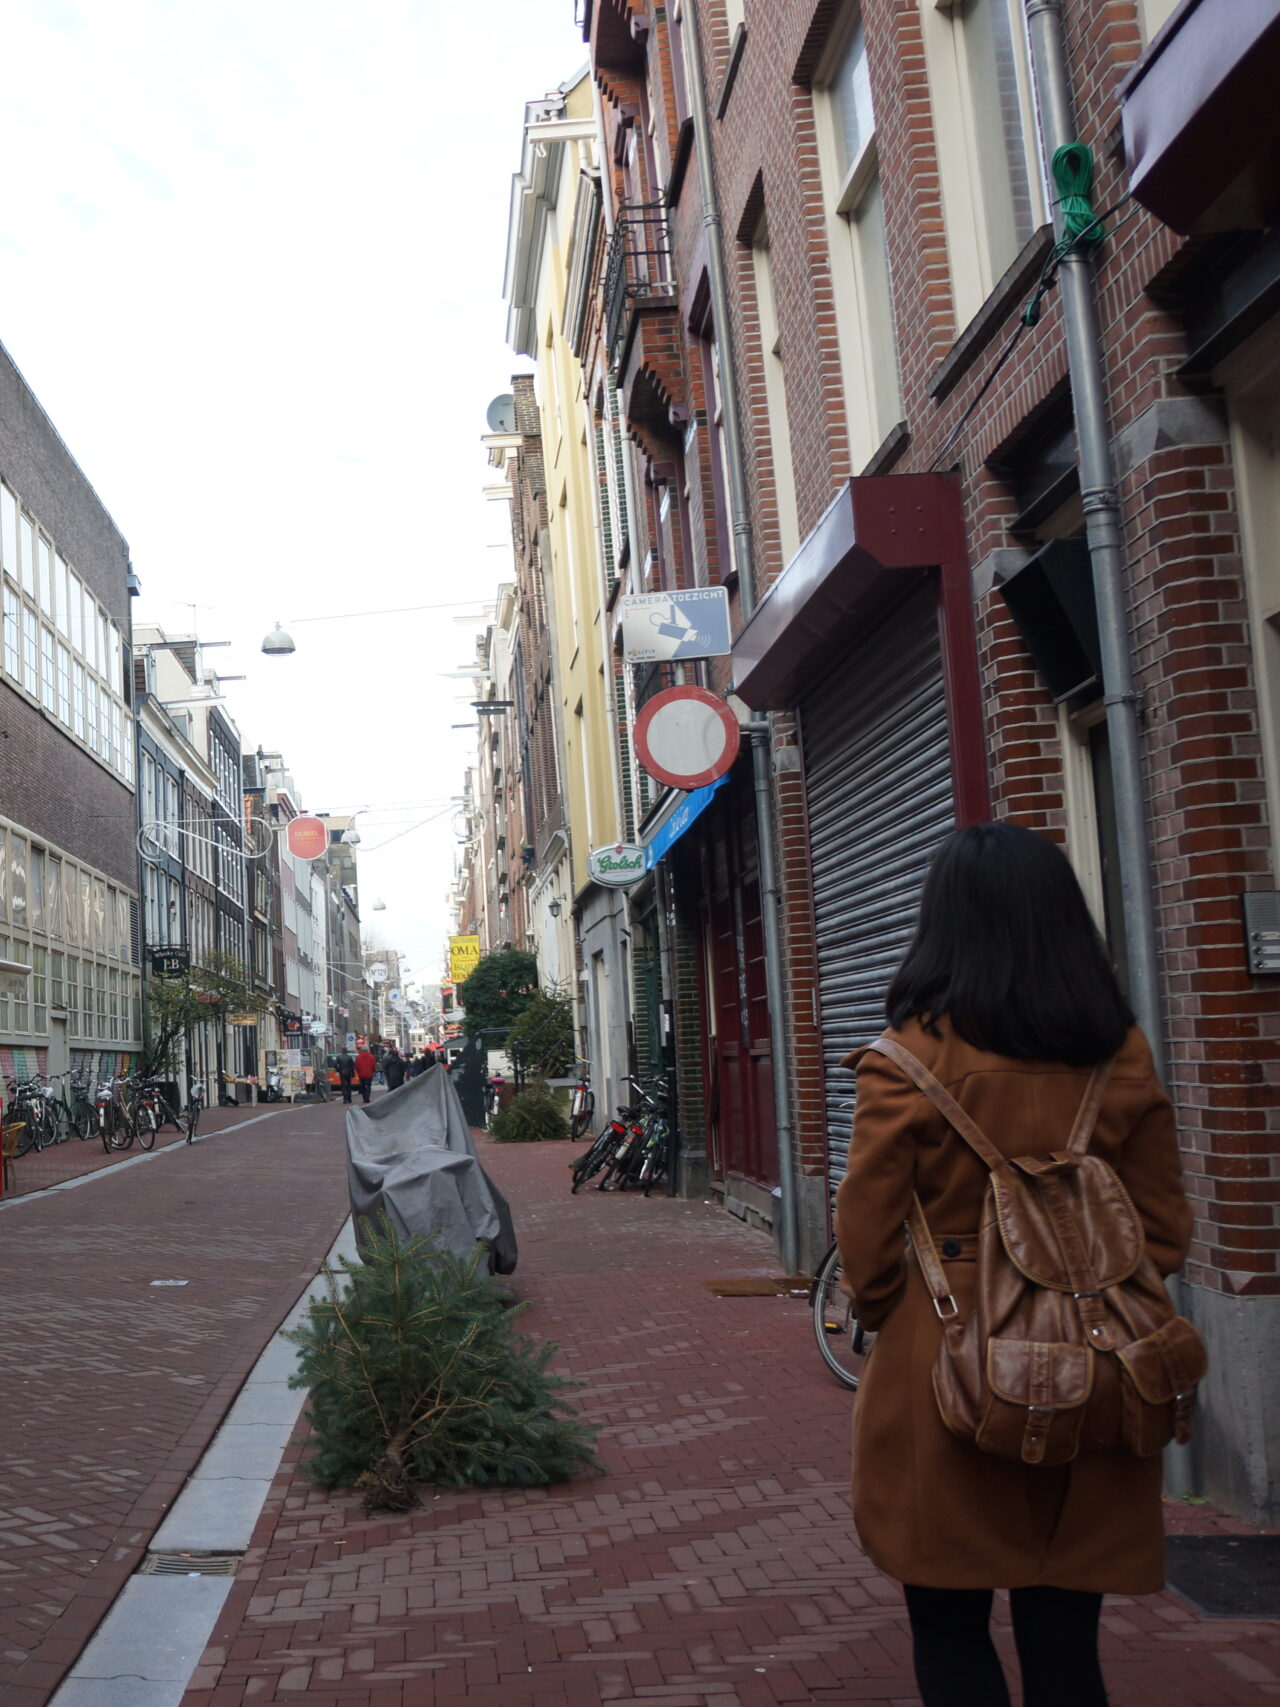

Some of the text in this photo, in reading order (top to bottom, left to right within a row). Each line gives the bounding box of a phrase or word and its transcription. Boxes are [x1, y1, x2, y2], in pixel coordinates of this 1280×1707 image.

[624, 590, 724, 607] CAMERA TOEZICHT
[597, 855, 643, 874] Grolsch
[451, 945, 478, 956] OMA
